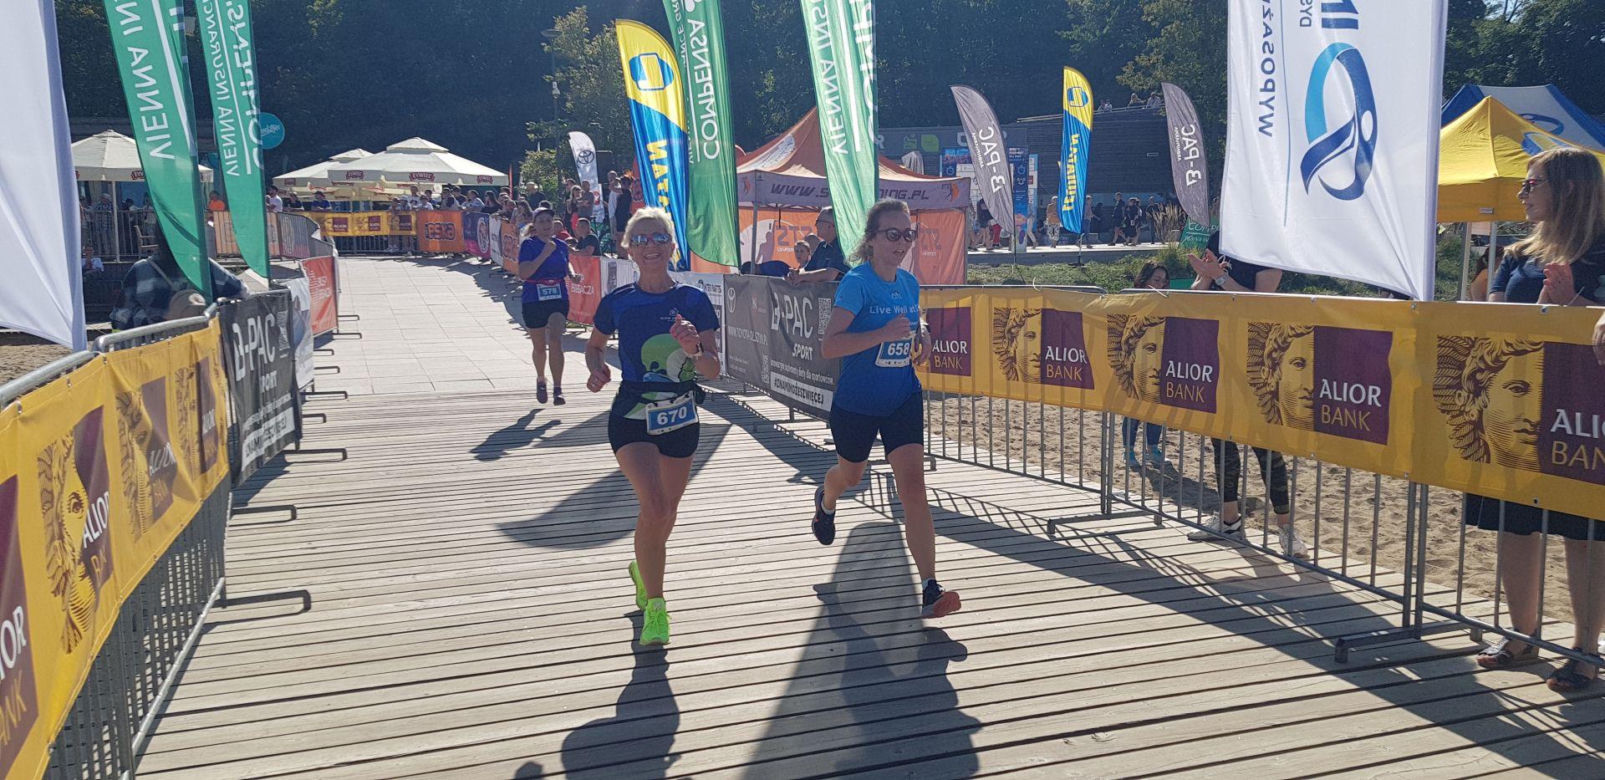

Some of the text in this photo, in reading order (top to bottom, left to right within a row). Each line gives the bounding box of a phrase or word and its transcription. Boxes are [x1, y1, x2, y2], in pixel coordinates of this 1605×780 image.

[792, 344, 813, 361] SPORT
[887, 343, 910, 356] 658
[932, 340, 967, 354] ALIOR
[1045, 345, 1087, 364] ALIOR
[934, 355, 963, 370] BANK
[1165, 360, 1213, 383] ALIOR
[1046, 364, 1082, 382] BANK
[1166, 381, 1205, 403] BANK
[1320, 378, 1382, 407] ALIOR
[657, 406, 688, 426] 670
[1321, 404, 1371, 432] BANK
[1550, 408, 1605, 439] ALI
[1551, 440, 1605, 471] BAN
